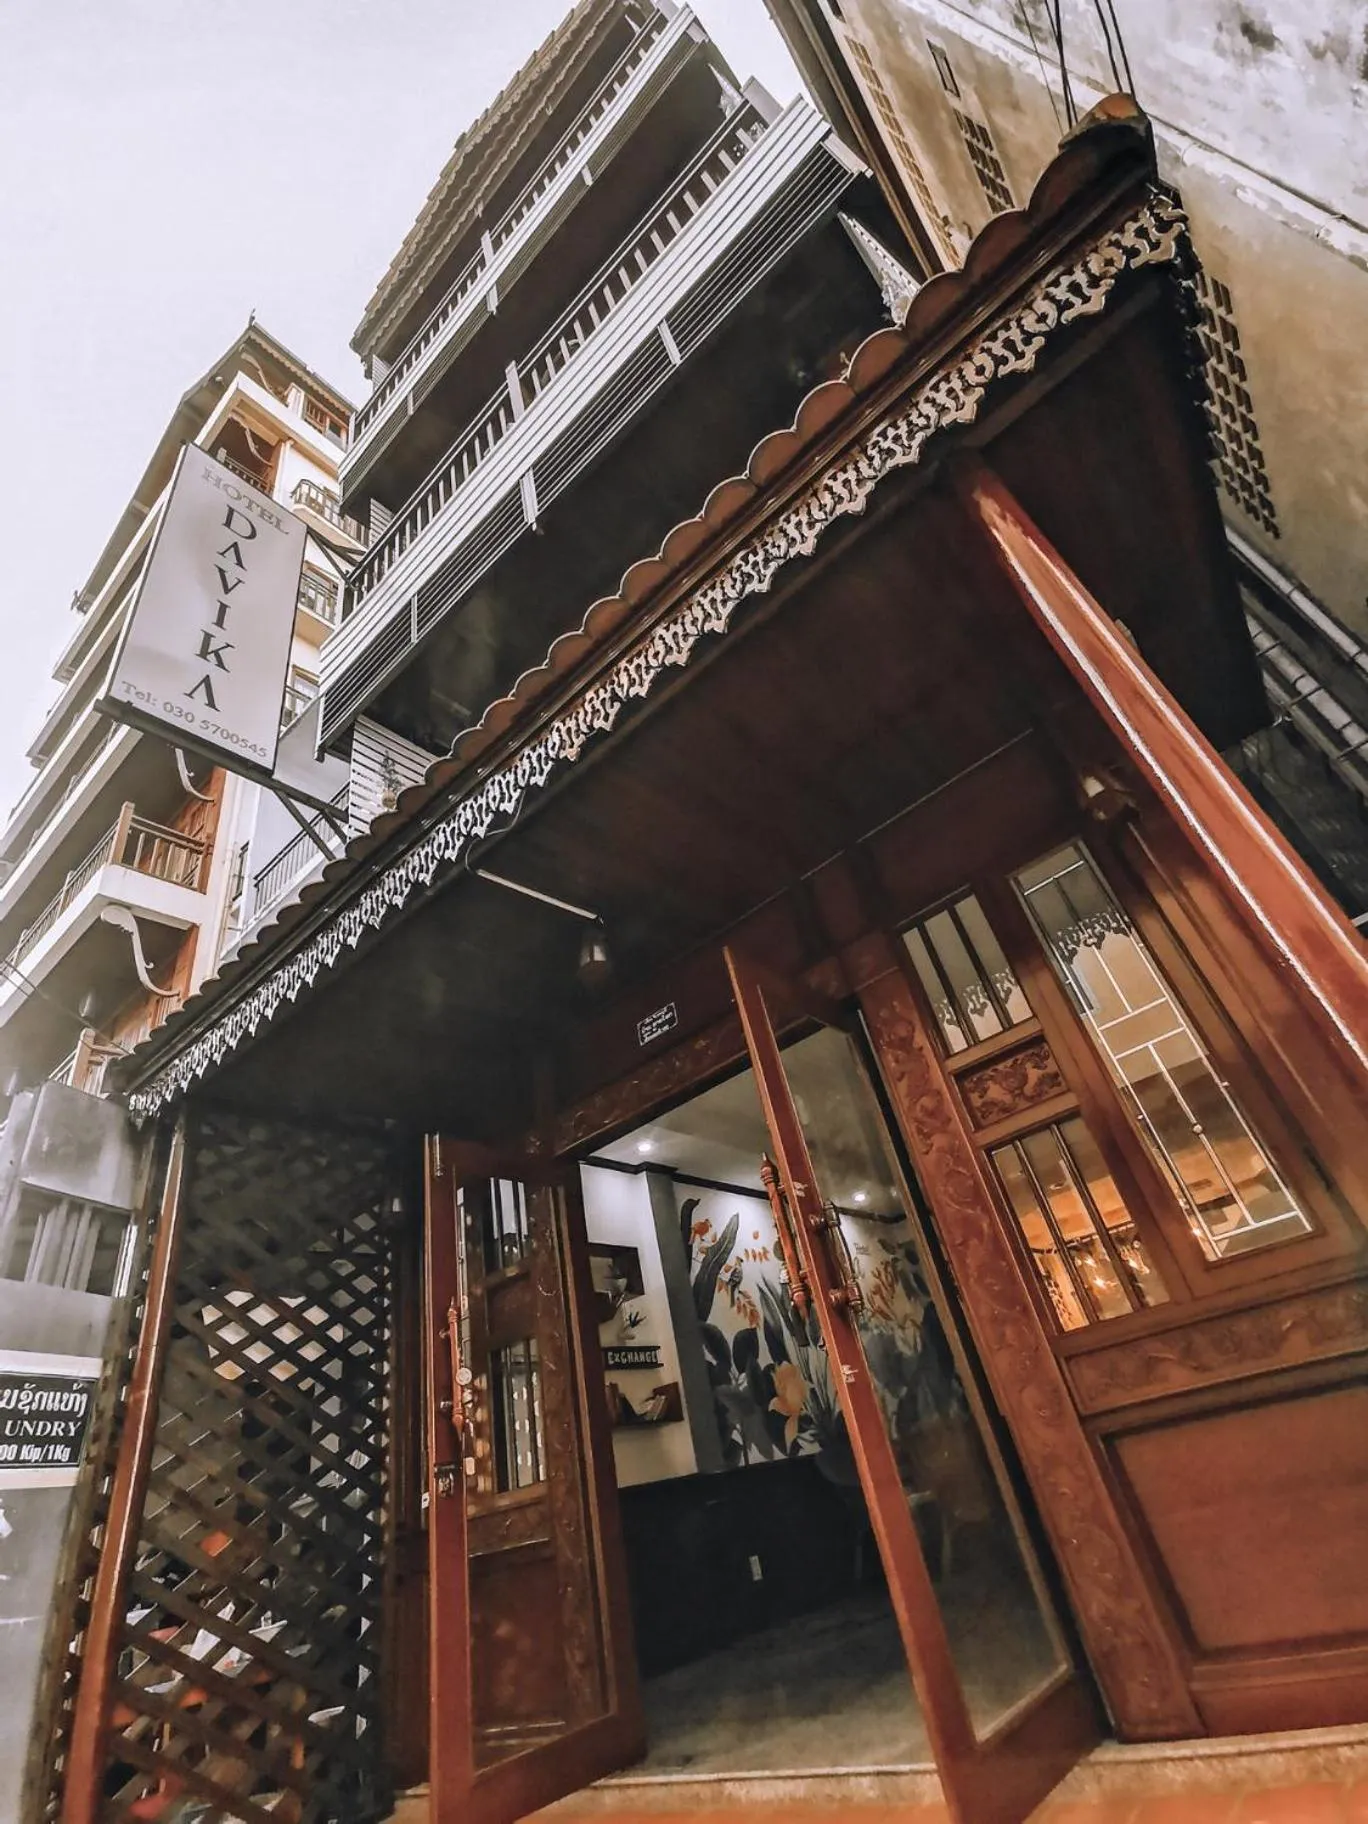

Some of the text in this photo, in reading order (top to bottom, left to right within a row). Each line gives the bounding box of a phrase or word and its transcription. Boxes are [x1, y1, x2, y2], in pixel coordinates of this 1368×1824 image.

[202, 466, 289, 535] HOTEL
[122, 681, 268, 757] Tel: 030 5700545
